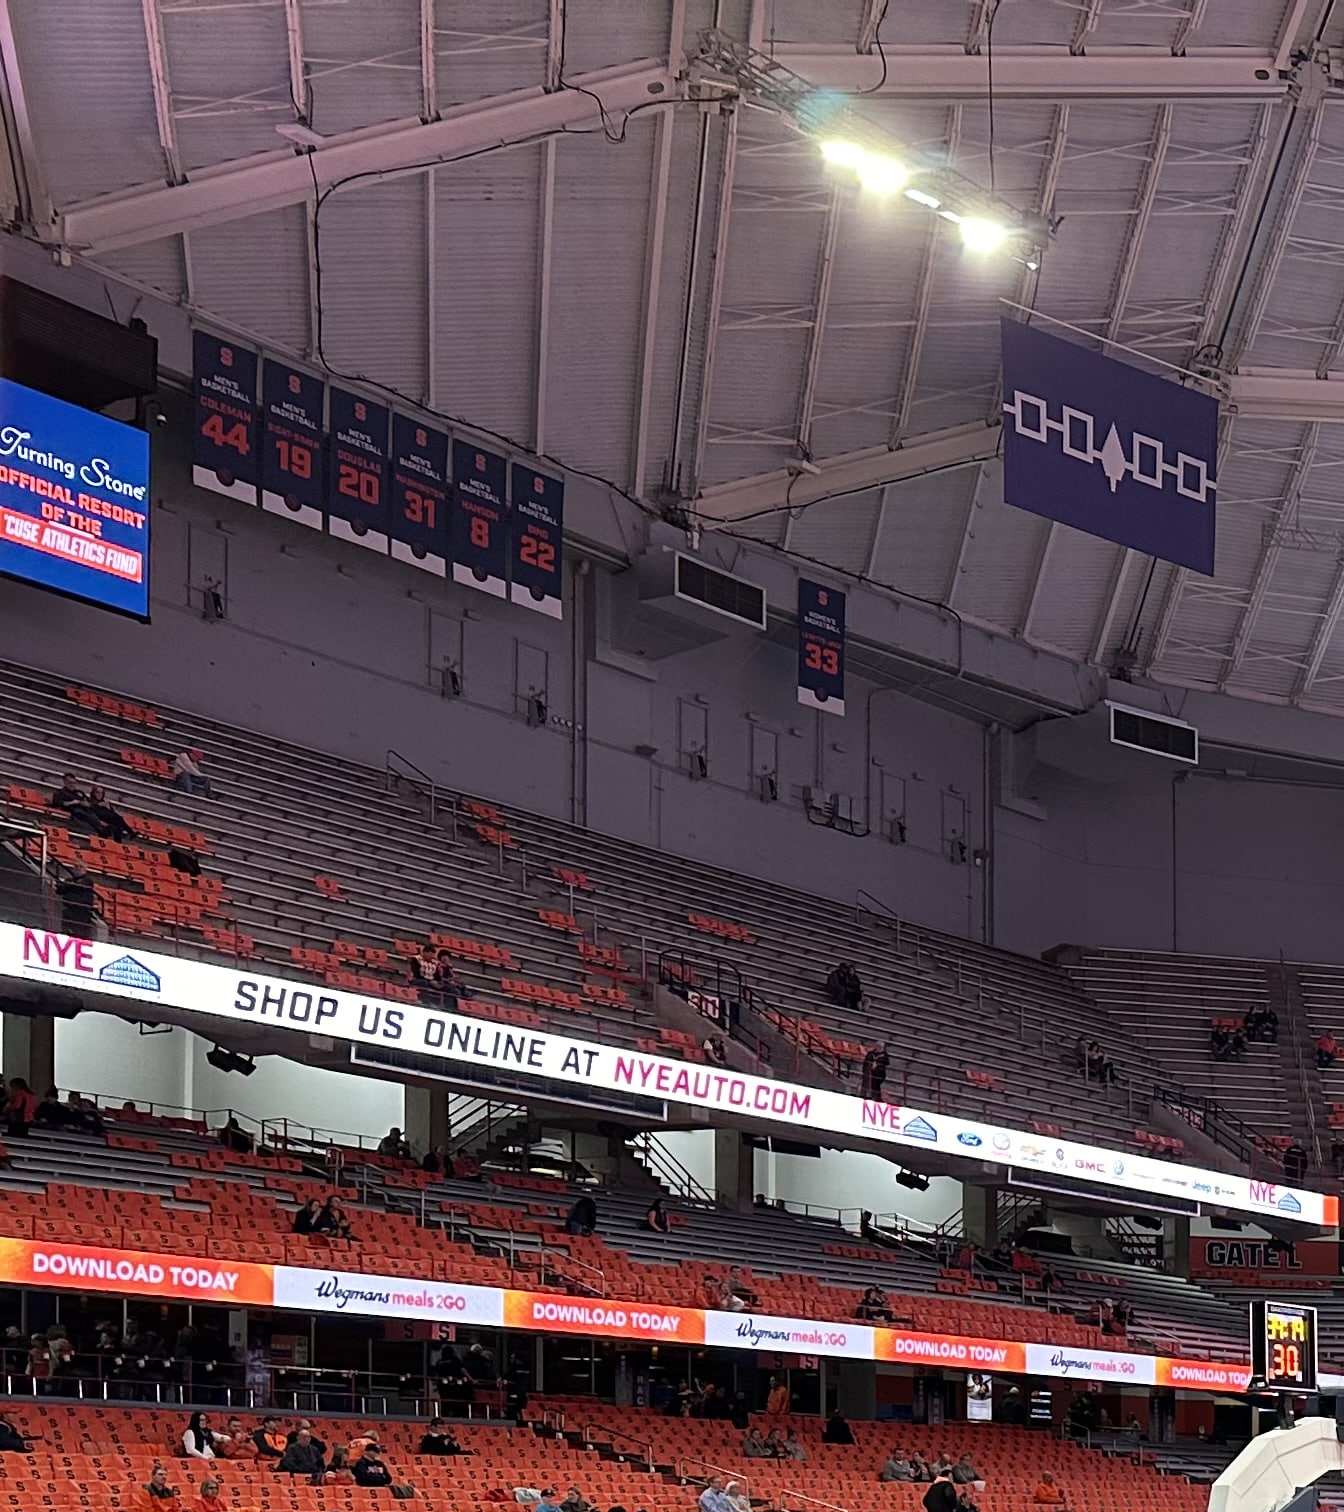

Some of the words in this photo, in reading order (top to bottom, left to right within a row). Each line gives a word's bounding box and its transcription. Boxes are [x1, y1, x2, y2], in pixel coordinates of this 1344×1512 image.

[202, 378, 250, 403] BASKETBALL
[202, 414, 250, 455] 44
[271, 404, 317, 430] BASKETBALL
[276, 440, 311, 479] 19
[337, 432, 382, 456] BASKETBALL
[0, 427, 75, 479] Turning
[80, 458, 143, 501] Stone
[400, 457, 441, 481] BASKETBALL
[339, 464, 380, 504] 20
[459, 482, 500, 505] BASKETBALL
[41, 502, 64, 521] OF
[67, 510, 102, 536] THE
[78, 493, 146, 529] RESORT
[404, 490, 435, 528] 31
[518, 504, 558, 526] BASKETBALL
[470, 516, 489, 548] 8
[41, 527, 105, 564] ATHLETICS
[106, 551, 138, 575] FUND
[520, 534, 555, 573] 22
[805, 642, 838, 676] 33
[23, 927, 94, 973] NYE
[234, 980, 339, 1025] SHOP
[358, 1004, 405, 1040] US
[424, 1018, 547, 1068] ONLINE
[560, 1047, 600, 1077] AT
[614, 1056, 811, 1119] NYEAUTO.COM
[862, 1099, 901, 1130] NYE
[1075, 1158, 1106, 1173] GMC
[1250, 1179, 1277, 1205] NYE
[1206, 1240, 1279, 1269] GATE
[33, 1252, 164, 1284] DOWNLOAD
[171, 1265, 239, 1292] TODAY
[316, 1276, 391, 1309] Wegmans
[392, 1289, 433, 1309] meals
[436, 1296, 466, 1312] 2GO
[533, 1303, 627, 1328] DOWNLOAD
[631, 1311, 681, 1333] TODAY
[735, 1318, 790, 1347] Wegmans
[791, 1329, 824, 1345] meals
[896, 1338, 966, 1361] DOWNLOAD
[969, 1345, 1007, 1363] TODAY
[1050, 1350, 1093, 1374] Wegmans
[1171, 1365, 1227, 1384] DOWNLOAD
[1273, 1343, 1299, 1377] 30
